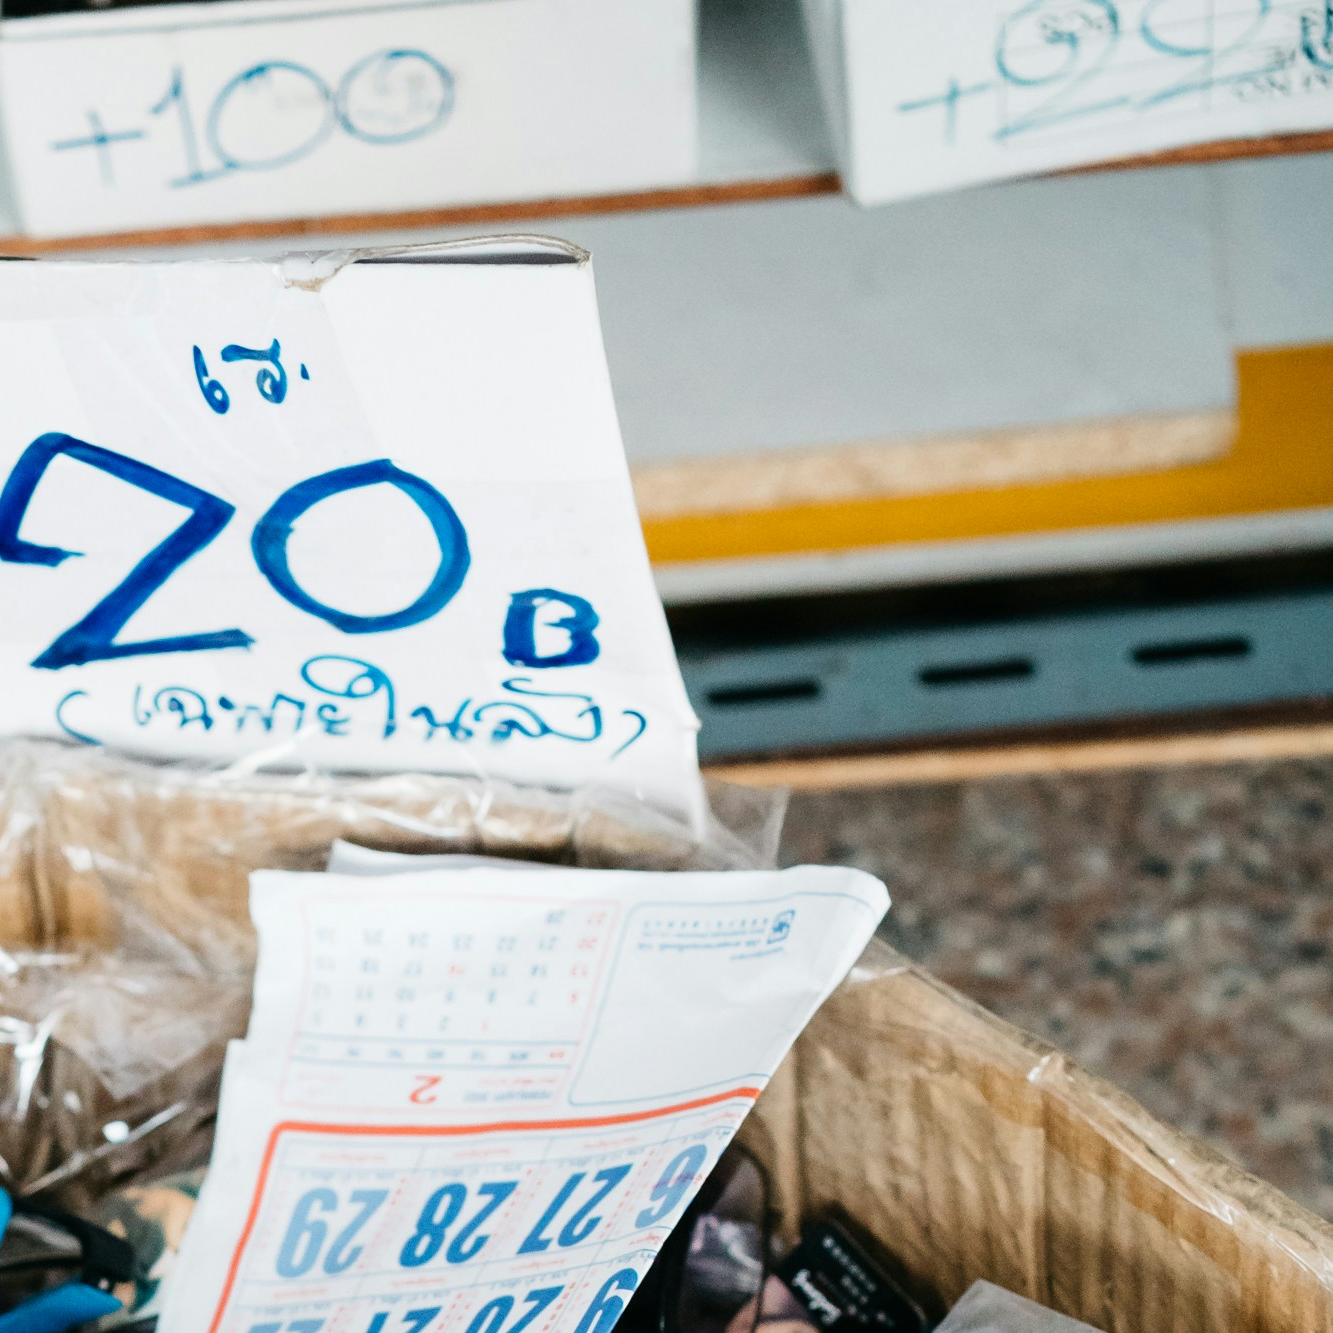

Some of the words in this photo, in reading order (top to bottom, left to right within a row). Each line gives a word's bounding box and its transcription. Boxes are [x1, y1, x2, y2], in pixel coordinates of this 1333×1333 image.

[51, 48, 456, 188] +100
[408, 1074, 444, 1105] 2
[277, 1186, 388, 1278] 29
[398, 1179, 520, 1269] 28
[516, 1162, 634, 1257] 27
